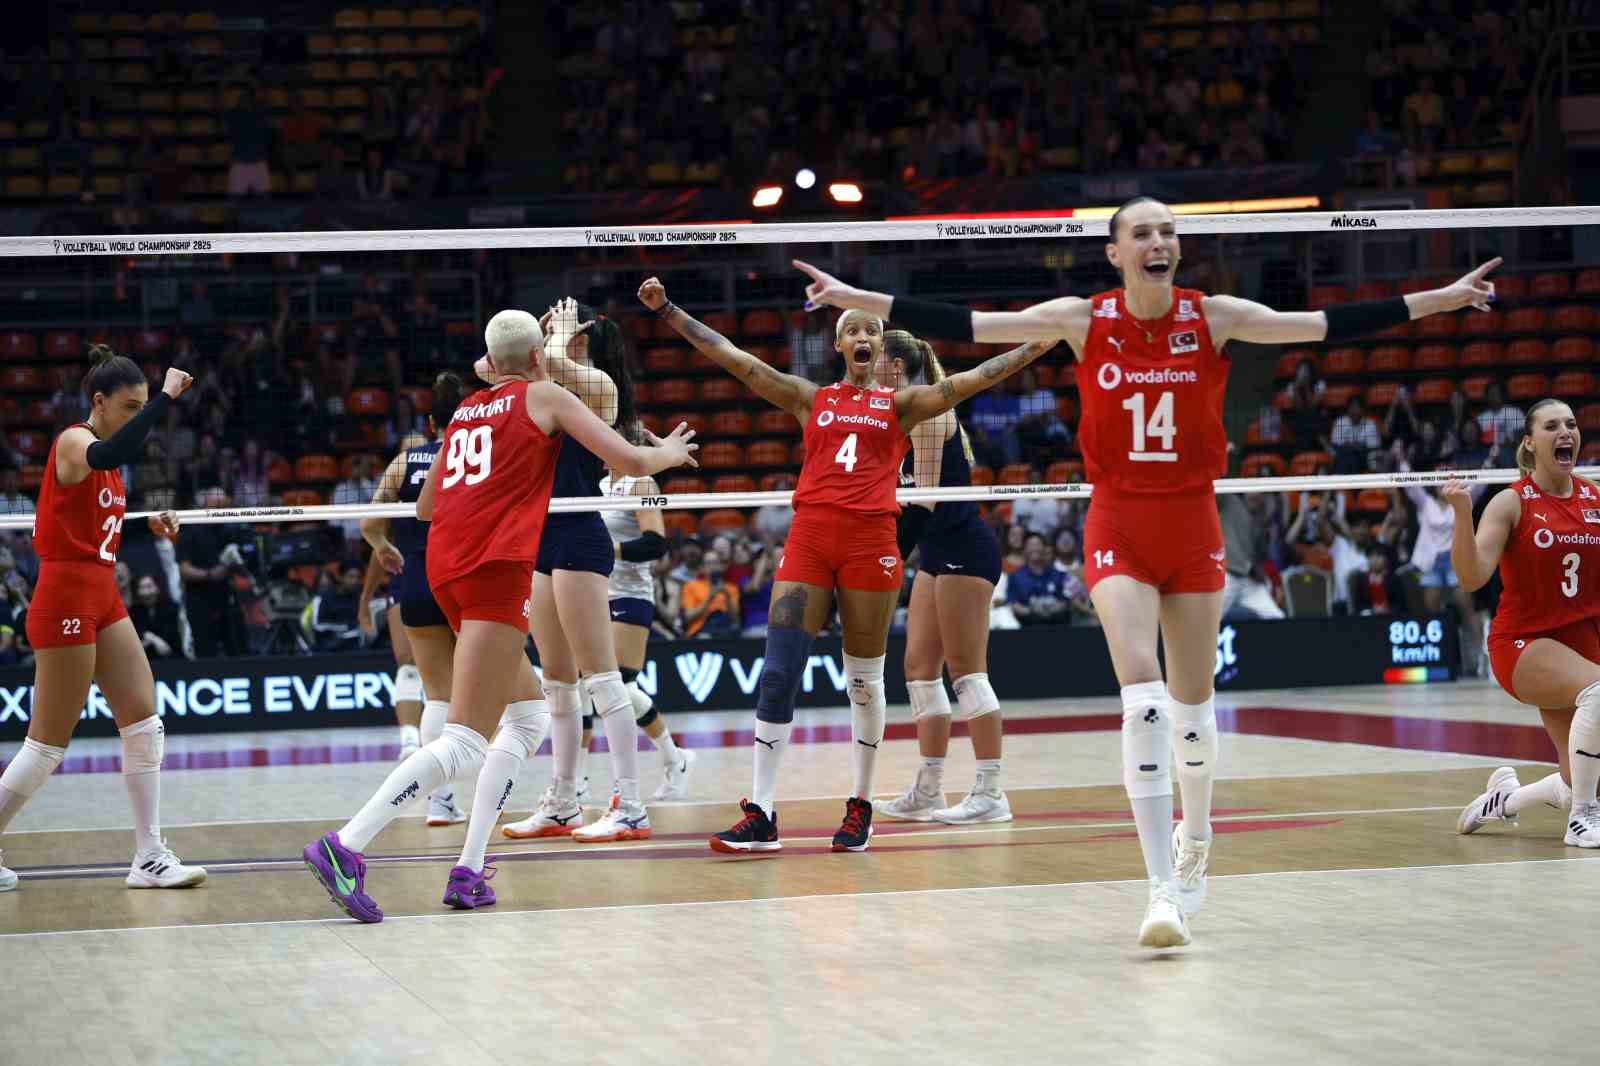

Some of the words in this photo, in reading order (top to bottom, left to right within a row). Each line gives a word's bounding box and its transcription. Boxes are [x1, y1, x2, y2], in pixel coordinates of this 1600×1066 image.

[594, 232, 637, 243] VOLLEYBALL
[638, 232, 664, 242] WORLD
[666, 231, 716, 242] CHAMPIONSHIP
[945, 225, 986, 236] VOLLEYBALL
[988, 225, 1013, 235] WORLD
[1014, 224, 1062, 234] CHAMPIONSHIP
[63, 241, 107, 252] VOLLEYBALL
[109, 241, 135, 251] WORLD
[138, 240, 191, 251] CHAMPIONSHIP
[1125, 369, 1197, 383] vodafone
[836, 414, 888, 430] vodafone
[1122, 391, 1177, 451] 14
[442, 425, 493, 489] 99
[835, 433, 858, 472] 4
[1093, 549, 1114, 569] 14
[1561, 552, 1580, 598] 3
[63, 618, 80, 634] 22
[1390, 619, 1442, 644] 80.6
[1392, 644, 1440, 662] km/h
